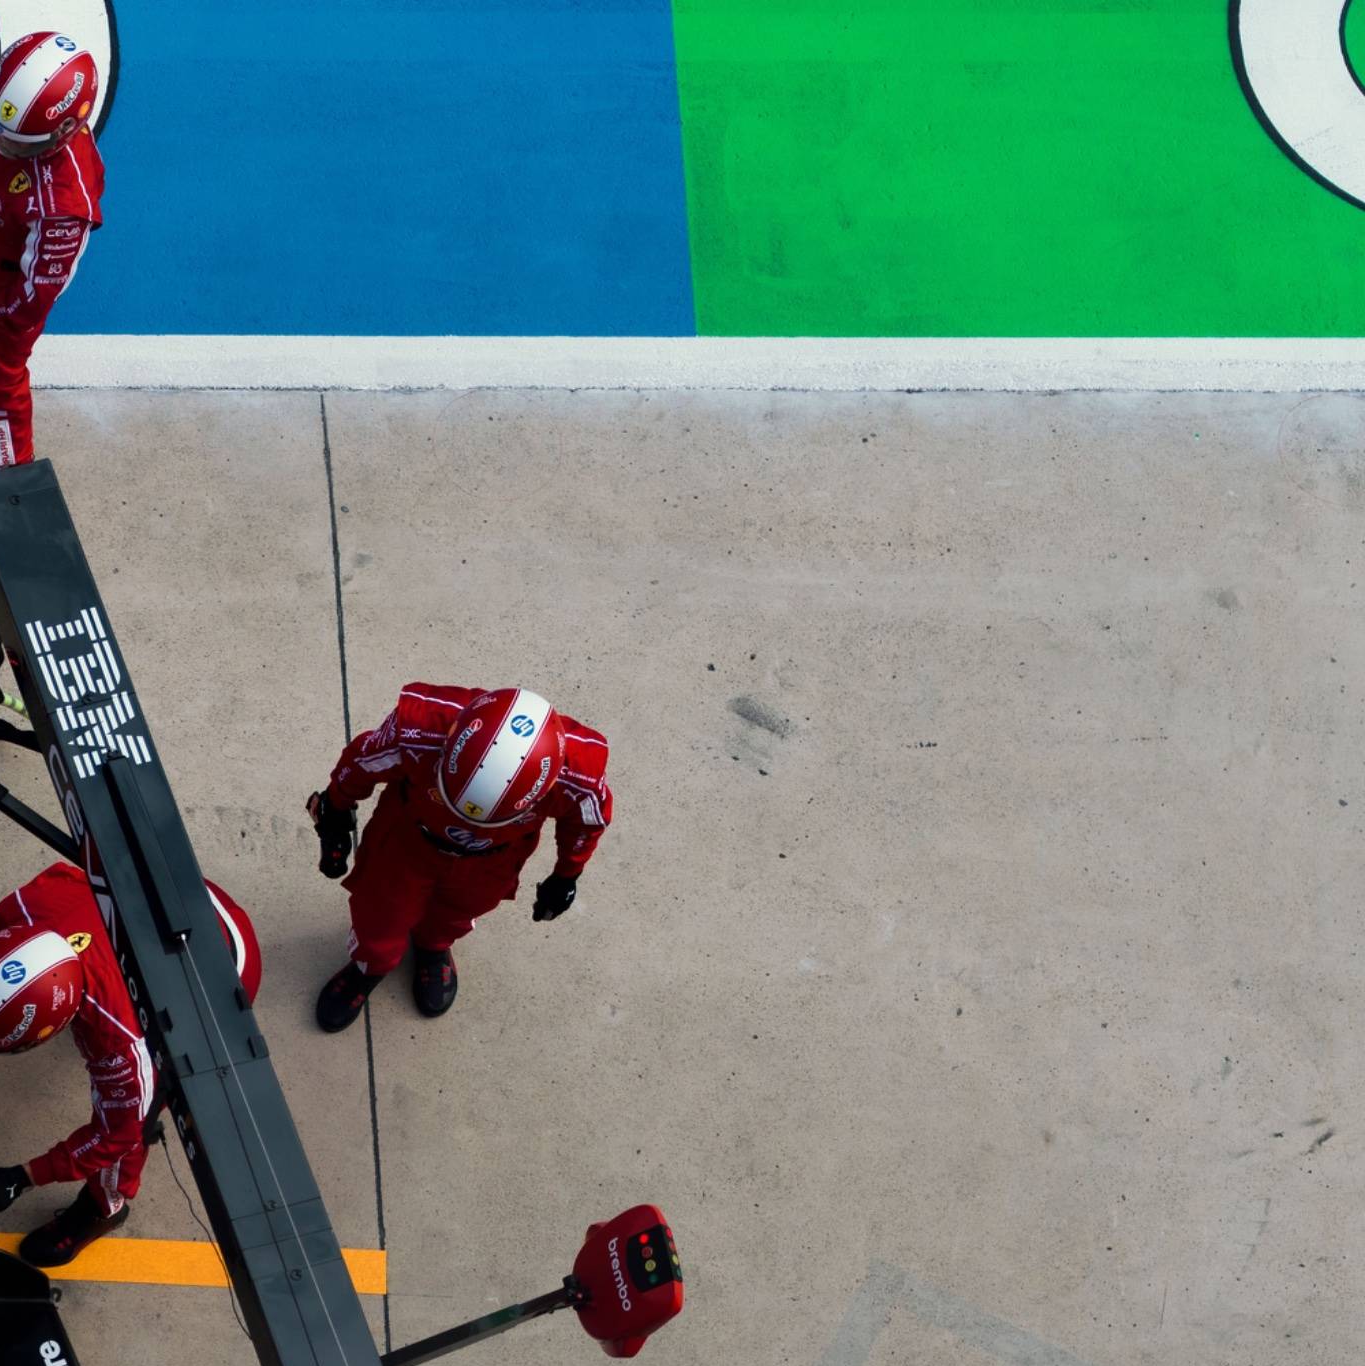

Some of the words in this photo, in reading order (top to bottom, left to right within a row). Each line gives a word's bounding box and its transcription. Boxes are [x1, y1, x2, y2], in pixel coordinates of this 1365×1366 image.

[56, 72, 85, 113] UniCredit
[25, 607, 151, 778] IBM
[511, 715, 535, 737] hp
[1, 960, 26, 985] hp
[607, 1237, 631, 1312] brembo
